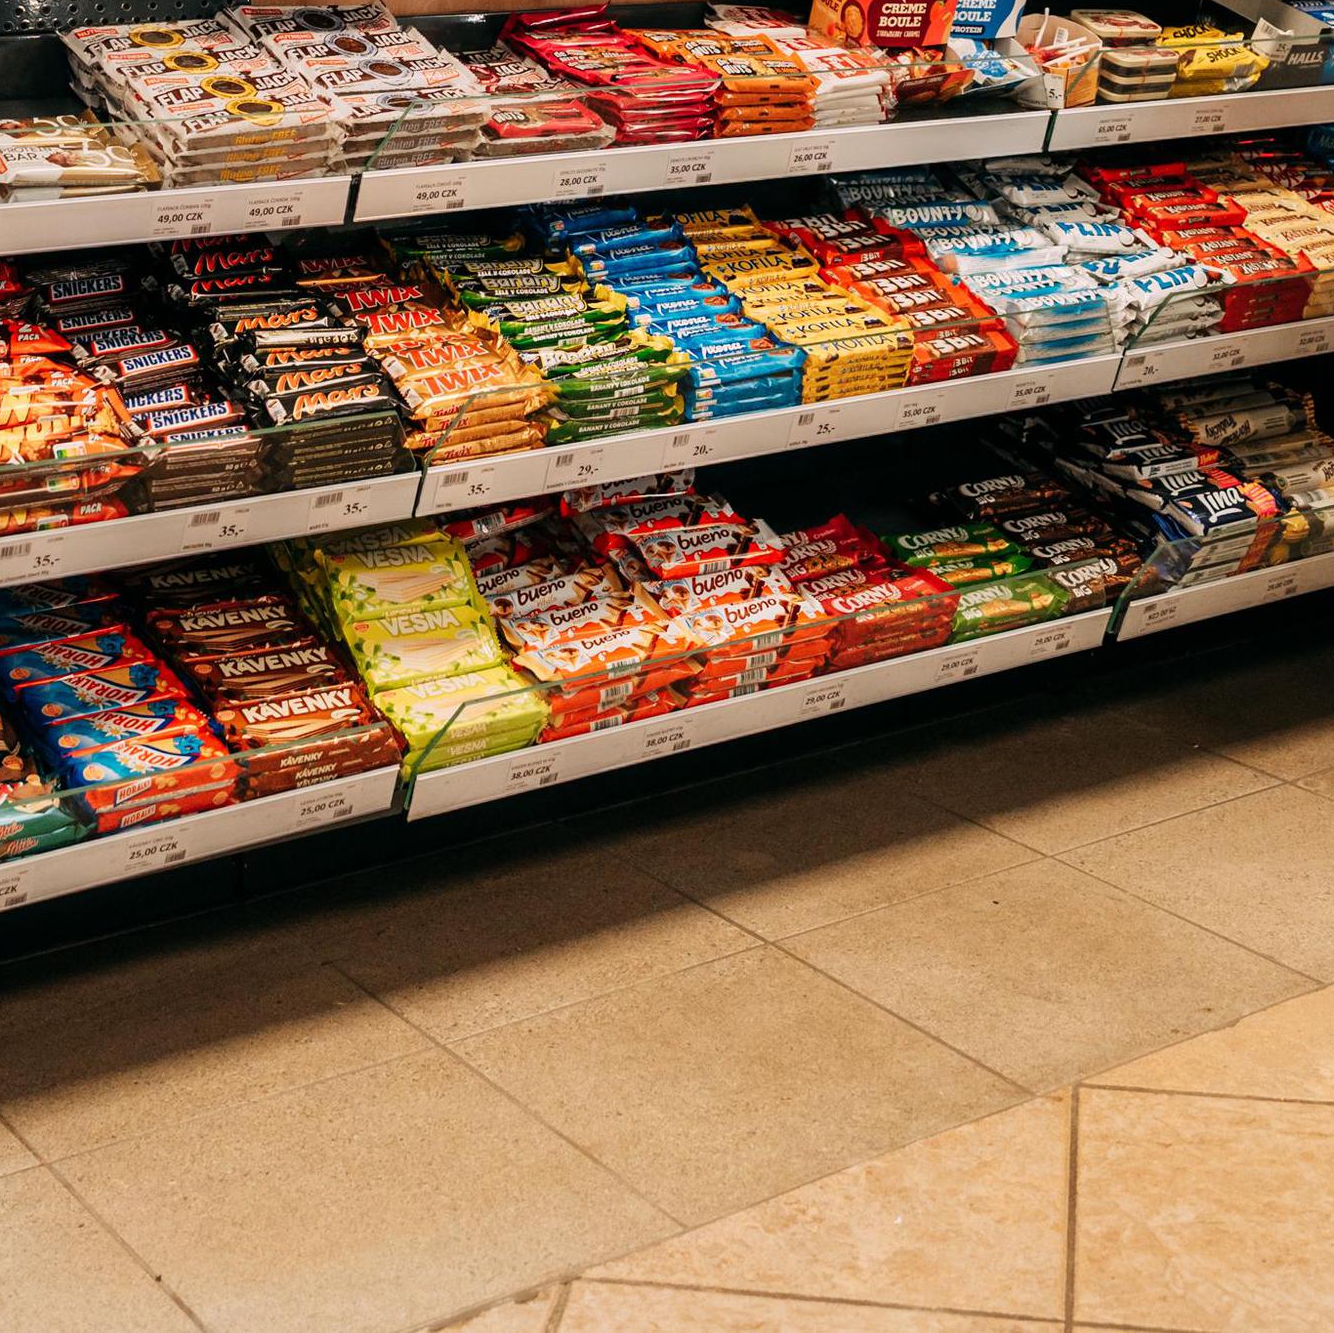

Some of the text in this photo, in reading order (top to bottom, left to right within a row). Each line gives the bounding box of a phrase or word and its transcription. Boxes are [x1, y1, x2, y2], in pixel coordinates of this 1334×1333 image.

[882, 0, 927, 15] CRÈME
[879, 16, 922, 29] BOULE
[1207, 47, 1241, 63] SHOCK!
[1289, 50, 1324, 65] HALLS
[159, 71, 299, 106] FLAP JACK
[158, 211, 203, 224] 49,00 CZK
[894, 207, 962, 226] BOUNTY
[53, 276, 124, 299] SNICKERS
[797, 317, 855, 338] KOFILA
[124, 346, 193, 373] SNICKERS
[294, 384, 380, 419] Mars
[344, 502, 368, 515] 35,-
[357, 546, 436, 569] VESNA
[517, 578, 566, 607] bueno
[832, 583, 899, 614] CORNY
[381, 608, 460, 636] VESNA
[551, 601, 599, 626] bueno
[242, 687, 353, 725] KÁVENKY
[511, 764, 550, 781] 38,00 CZK
